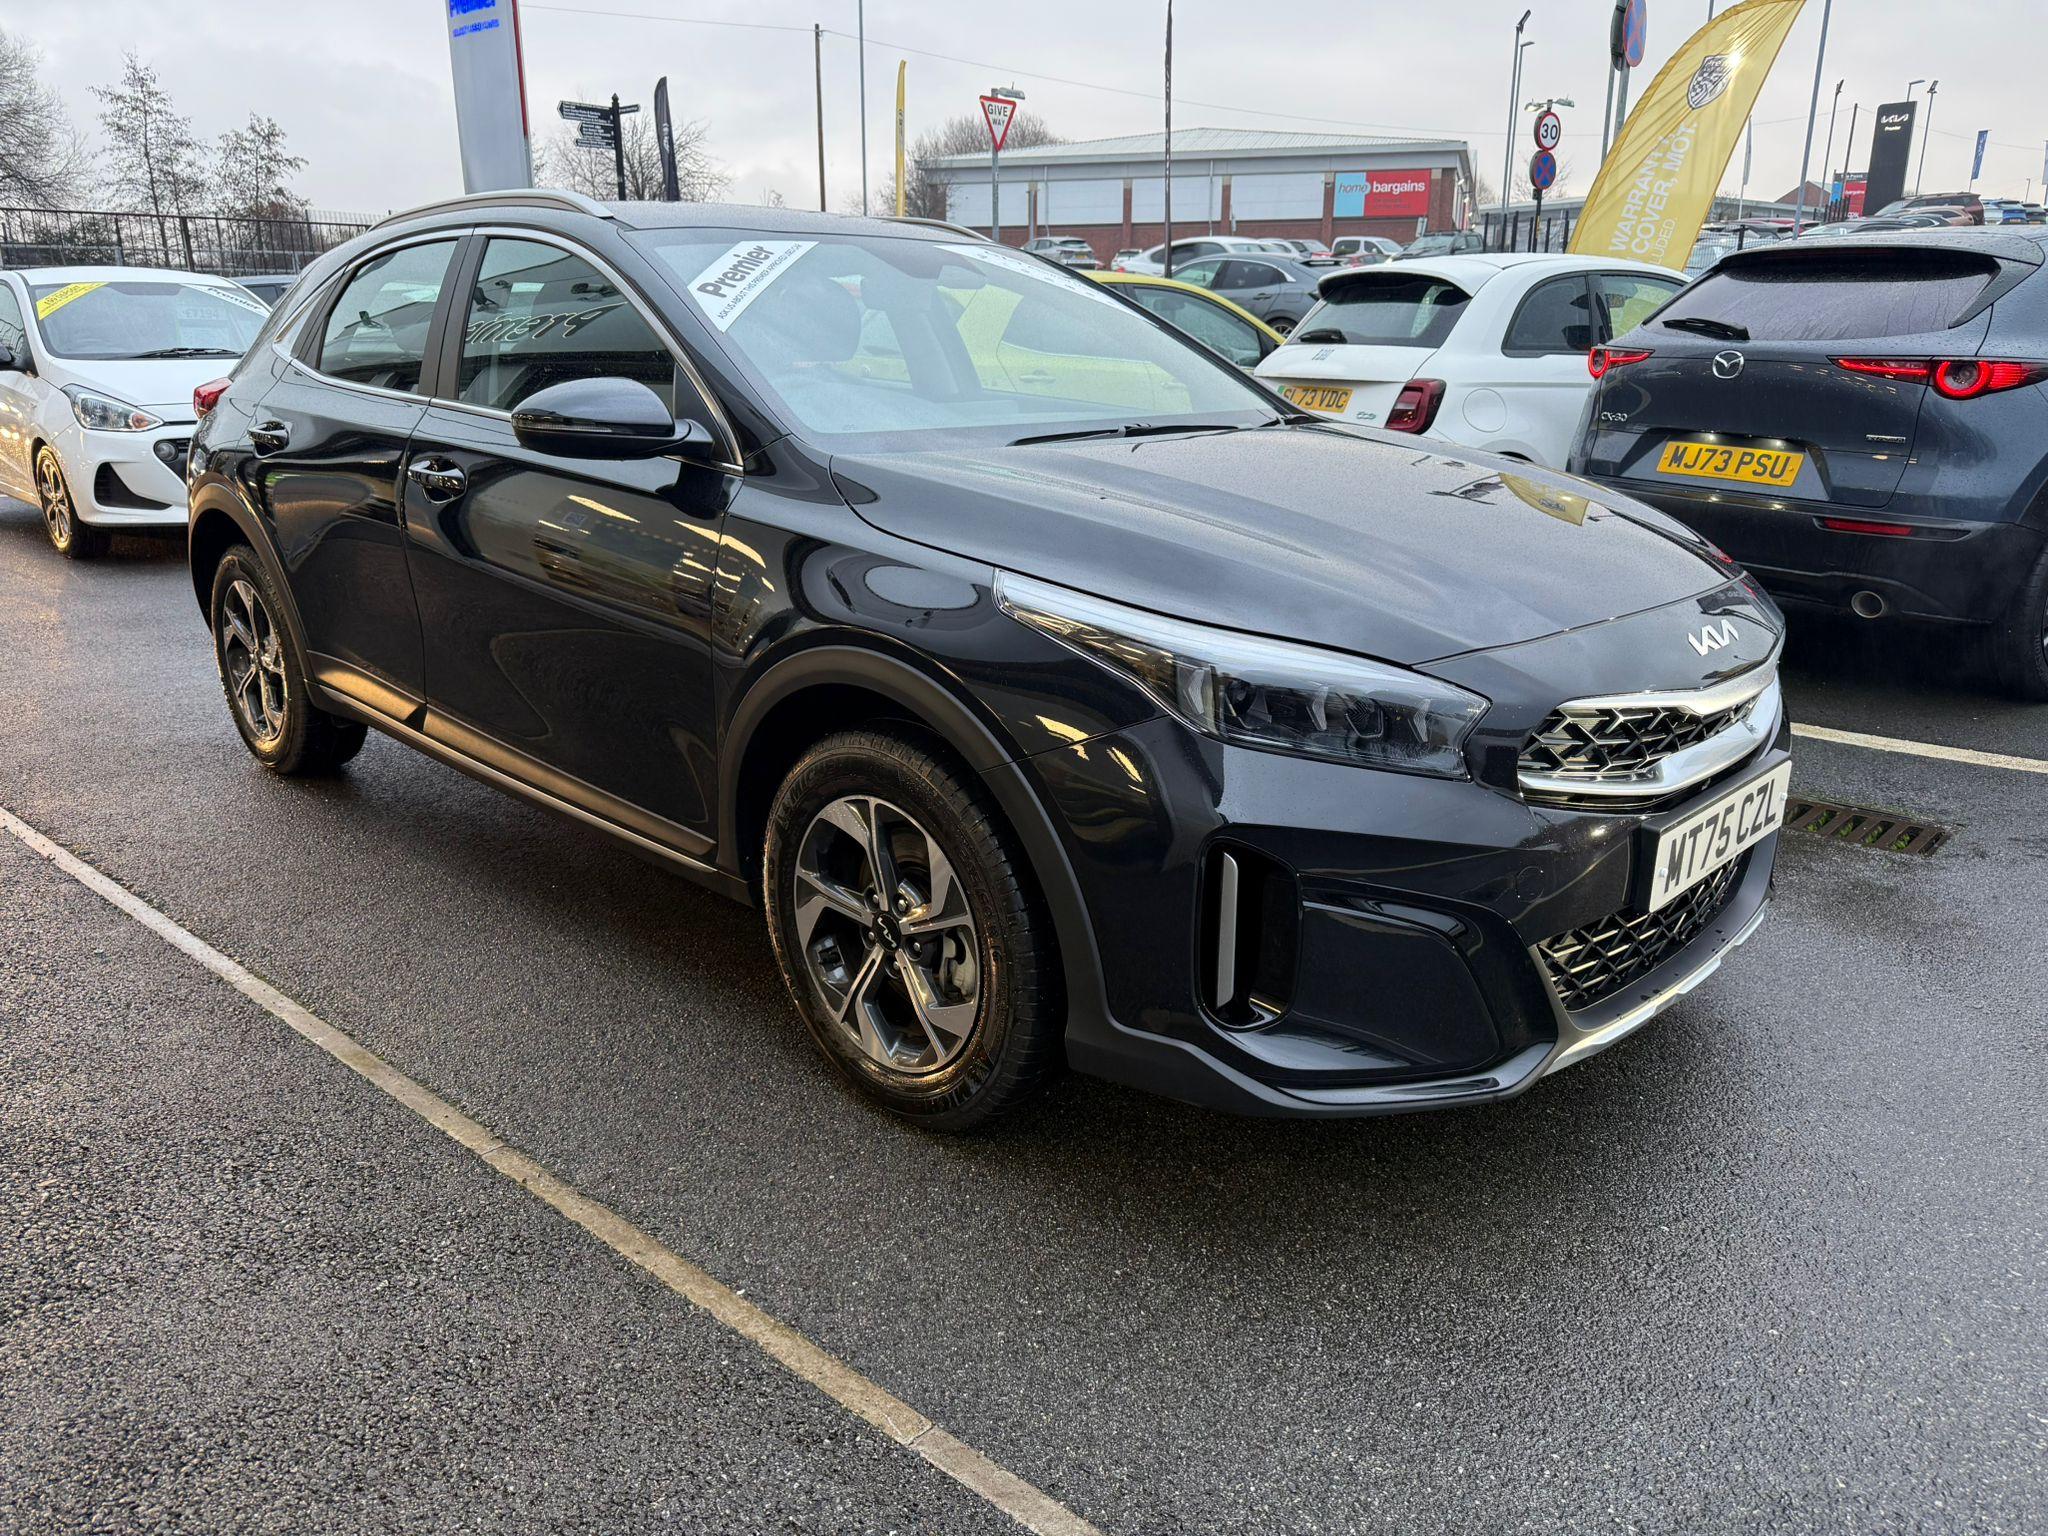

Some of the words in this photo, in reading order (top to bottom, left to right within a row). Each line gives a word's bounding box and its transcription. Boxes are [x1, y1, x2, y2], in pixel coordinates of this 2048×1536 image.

[988, 103, 1008, 117] GIVE
[992, 118, 1005, 126] WAY
[1541, 123, 1558, 140] 30
[1338, 182, 1368, 193] home
[1373, 179, 1426, 195] bargains
[1632, 177, 1678, 254] COVER,
[697, 245, 775, 298] Premier
[1600, 411, 1628, 422] CX-30
[1668, 445, 1731, 472] MJ73
[1734, 451, 1791, 479] PSU
[1688, 619, 1739, 657] KIA
[1664, 803, 1735, 894] MT75
[1736, 778, 1777, 845] CZL
